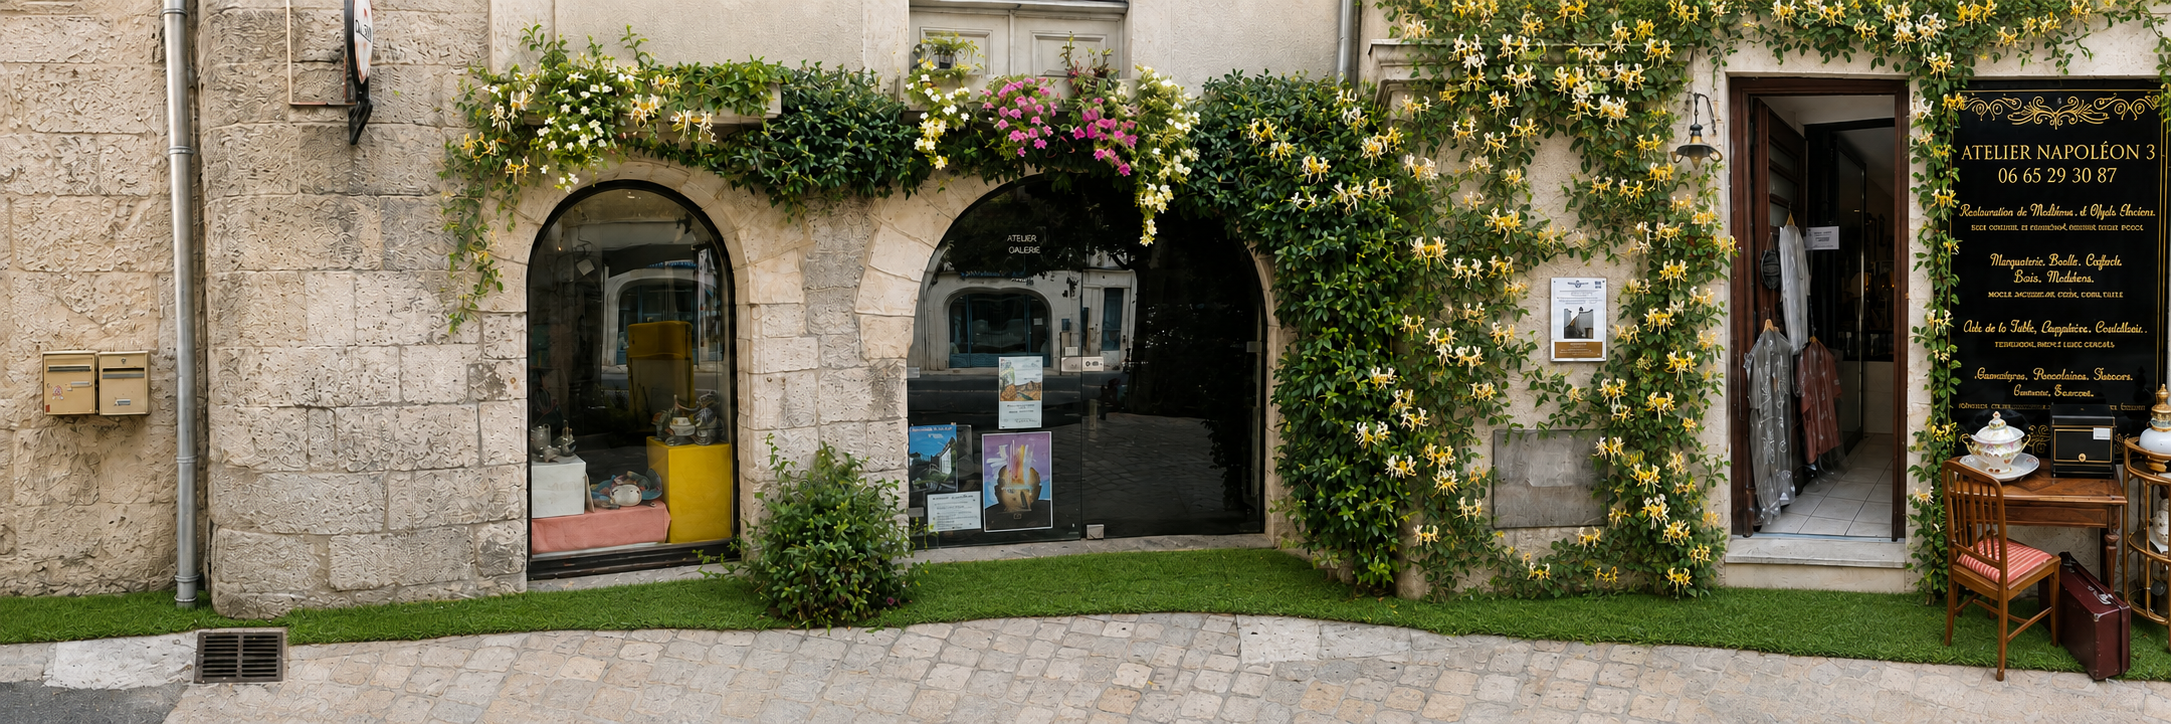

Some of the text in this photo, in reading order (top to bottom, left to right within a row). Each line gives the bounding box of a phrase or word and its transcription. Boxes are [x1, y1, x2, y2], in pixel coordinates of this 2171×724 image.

[1961, 140, 2156, 161] ATELIER NAPOLÉON 3
[1998, 167, 2117, 184] 06 65 29 30 87
[2016, 206, 2027, 217] de
[1007, 234, 1037, 242] ATELIER
[1984, 322, 1996, 333] de
